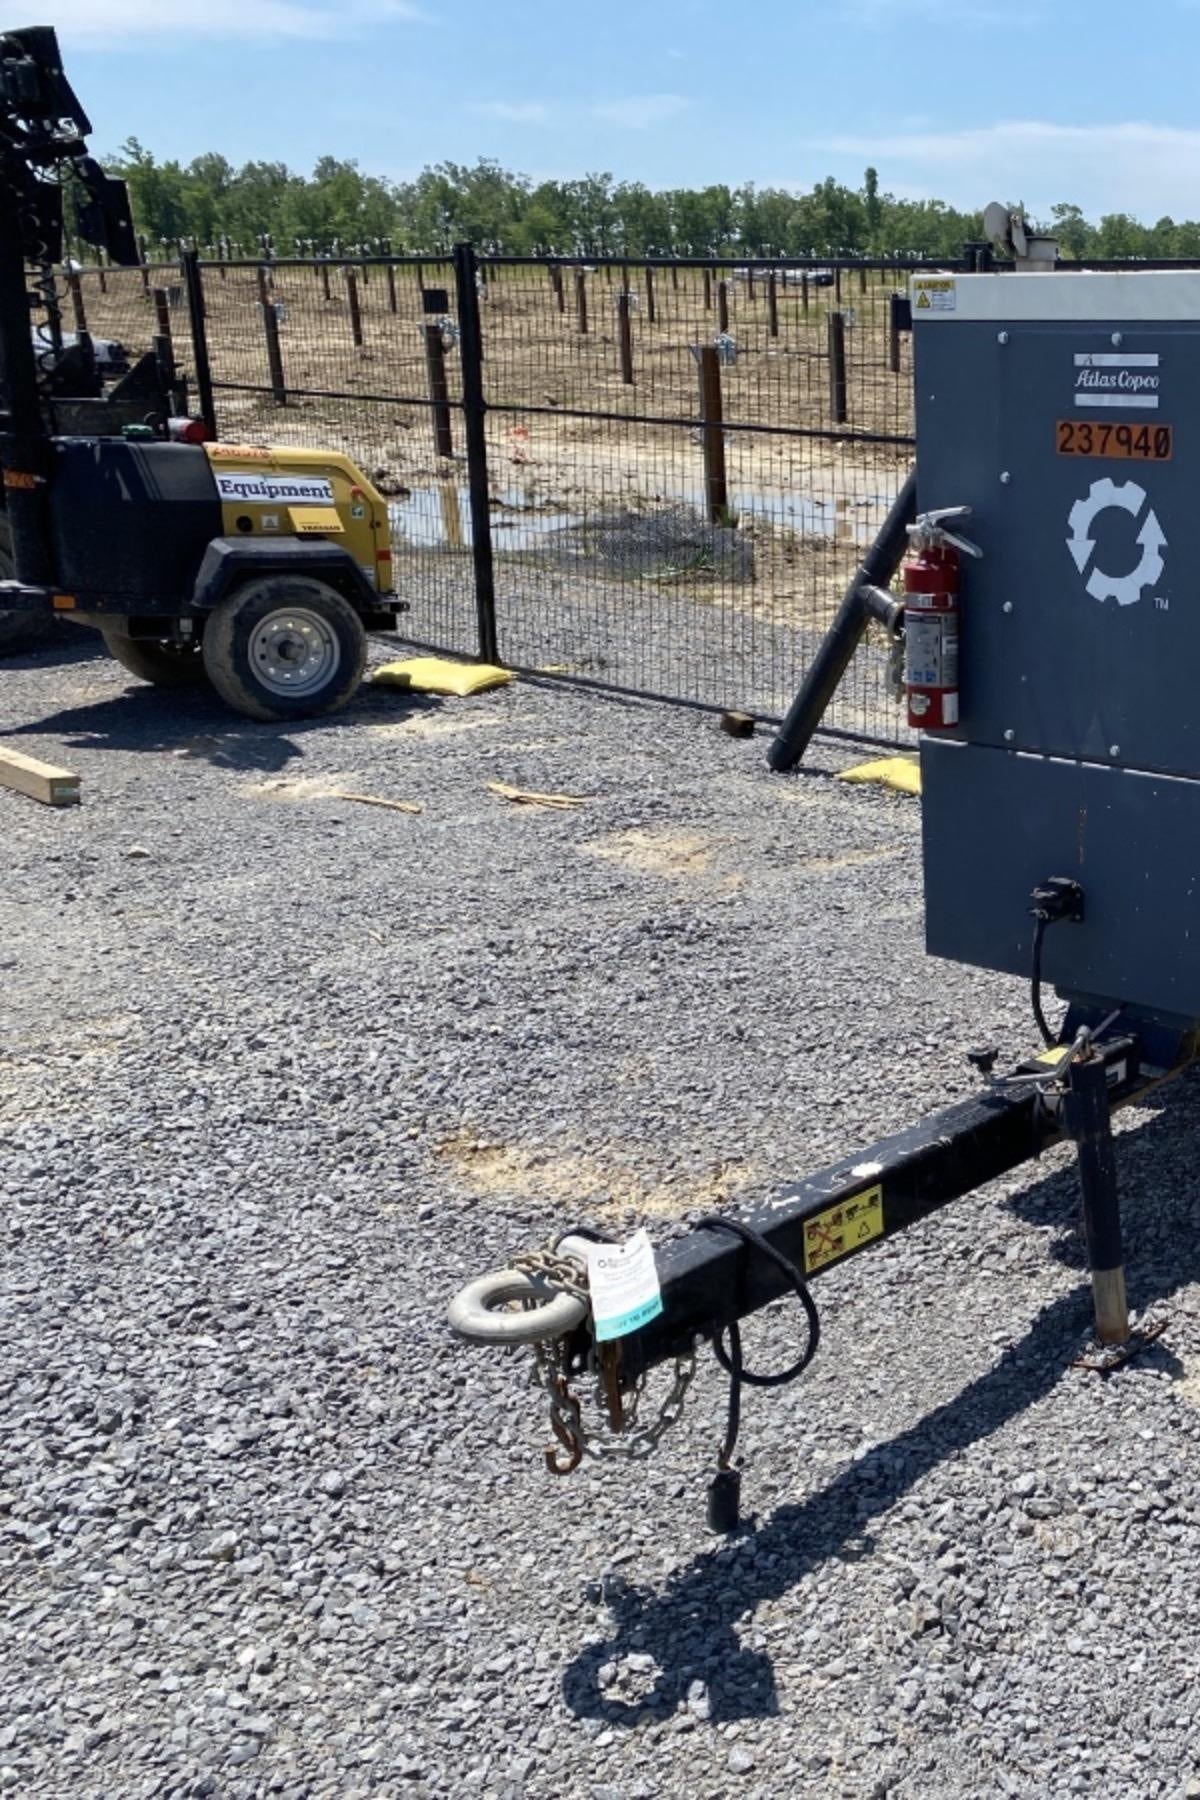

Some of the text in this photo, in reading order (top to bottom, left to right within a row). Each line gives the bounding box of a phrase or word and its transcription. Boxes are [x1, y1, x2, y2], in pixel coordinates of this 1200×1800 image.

[1075, 370, 1160, 392] Atlas Copco
[1060, 422, 1170, 459] 237940
[219, 479, 333, 499] Equipment
